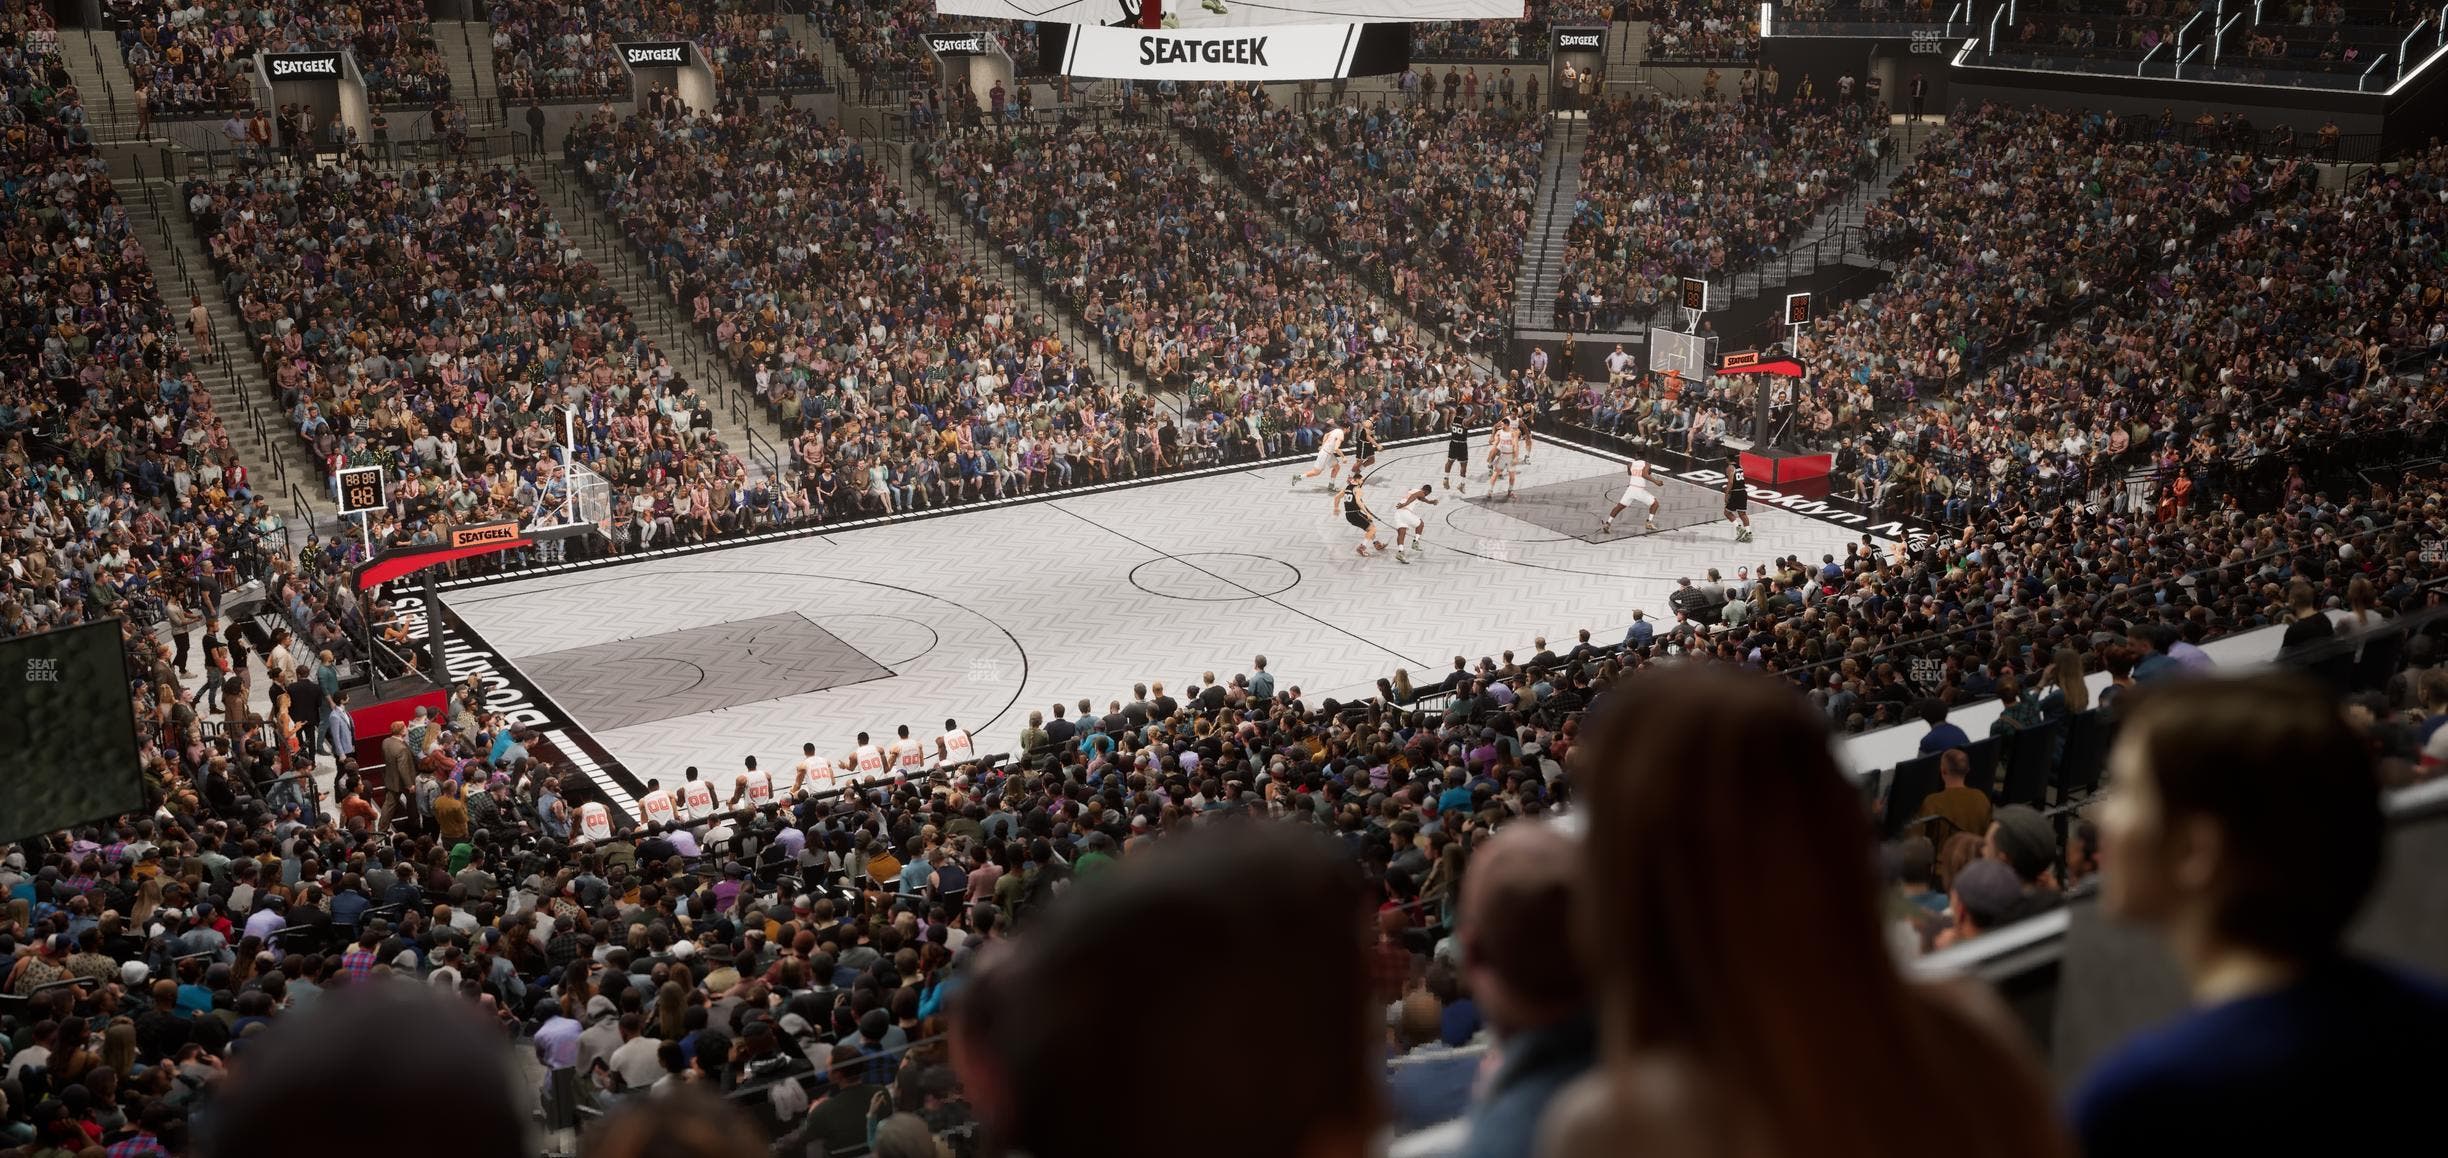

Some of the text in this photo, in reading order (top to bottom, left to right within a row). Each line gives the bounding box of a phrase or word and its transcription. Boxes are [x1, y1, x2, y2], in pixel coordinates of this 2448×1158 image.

[933, 38, 981, 52] SEATGEEK
[1560, 35, 1599, 46] SEATGEEK
[628, 47, 682, 63] SEATGEEK
[1140, 35, 1268, 66] SEATGEEK
[273, 58, 336, 75] SEATGEEK
[1727, 354, 1755, 366] SEATGEEK
[345, 472, 376, 487] 88 88
[351, 486, 374, 508] 88
[458, 527, 514, 544] SEATGEEK
